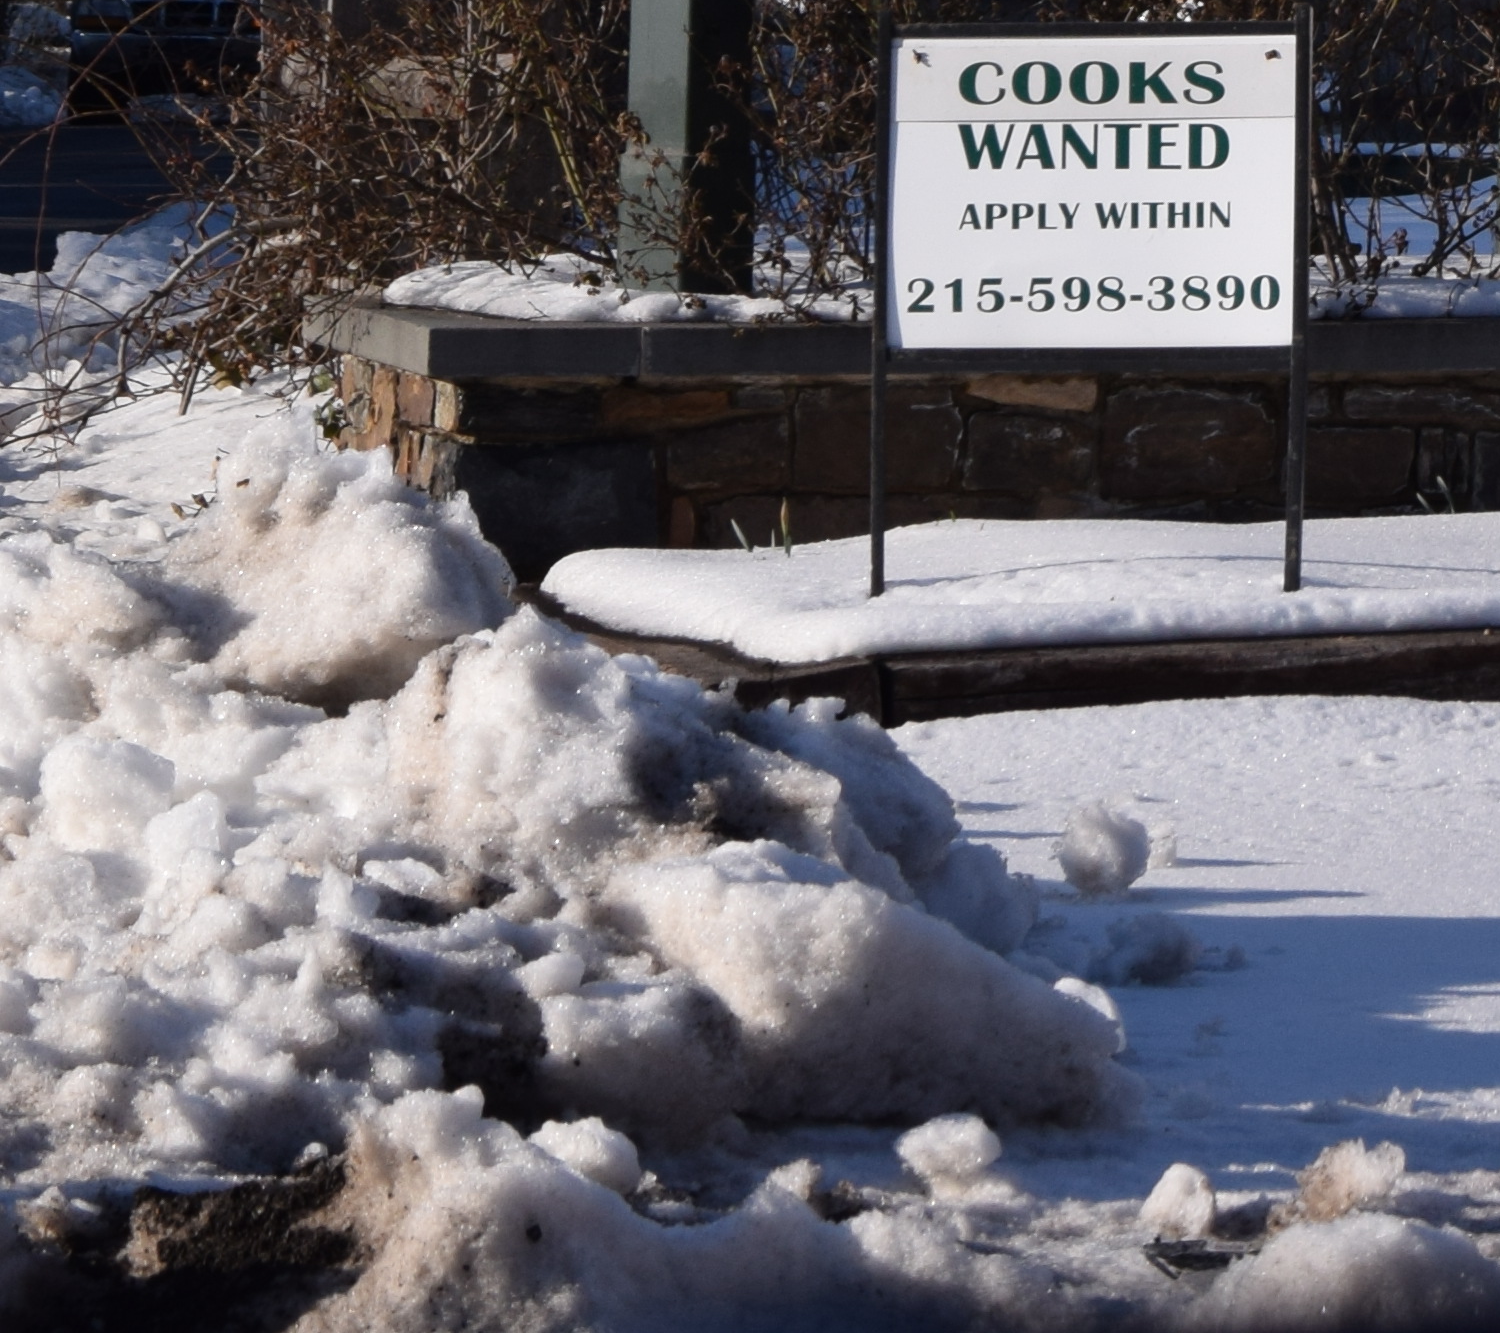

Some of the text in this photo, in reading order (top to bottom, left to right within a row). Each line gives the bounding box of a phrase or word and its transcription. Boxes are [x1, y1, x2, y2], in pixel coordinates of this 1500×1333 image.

[958, 61, 1225, 105] COOKS
[958, 123, 1231, 170] WANTED
[959, 201, 1232, 230] APPLY WITHIN
[907, 274, 1280, 314] 215-598-3890
